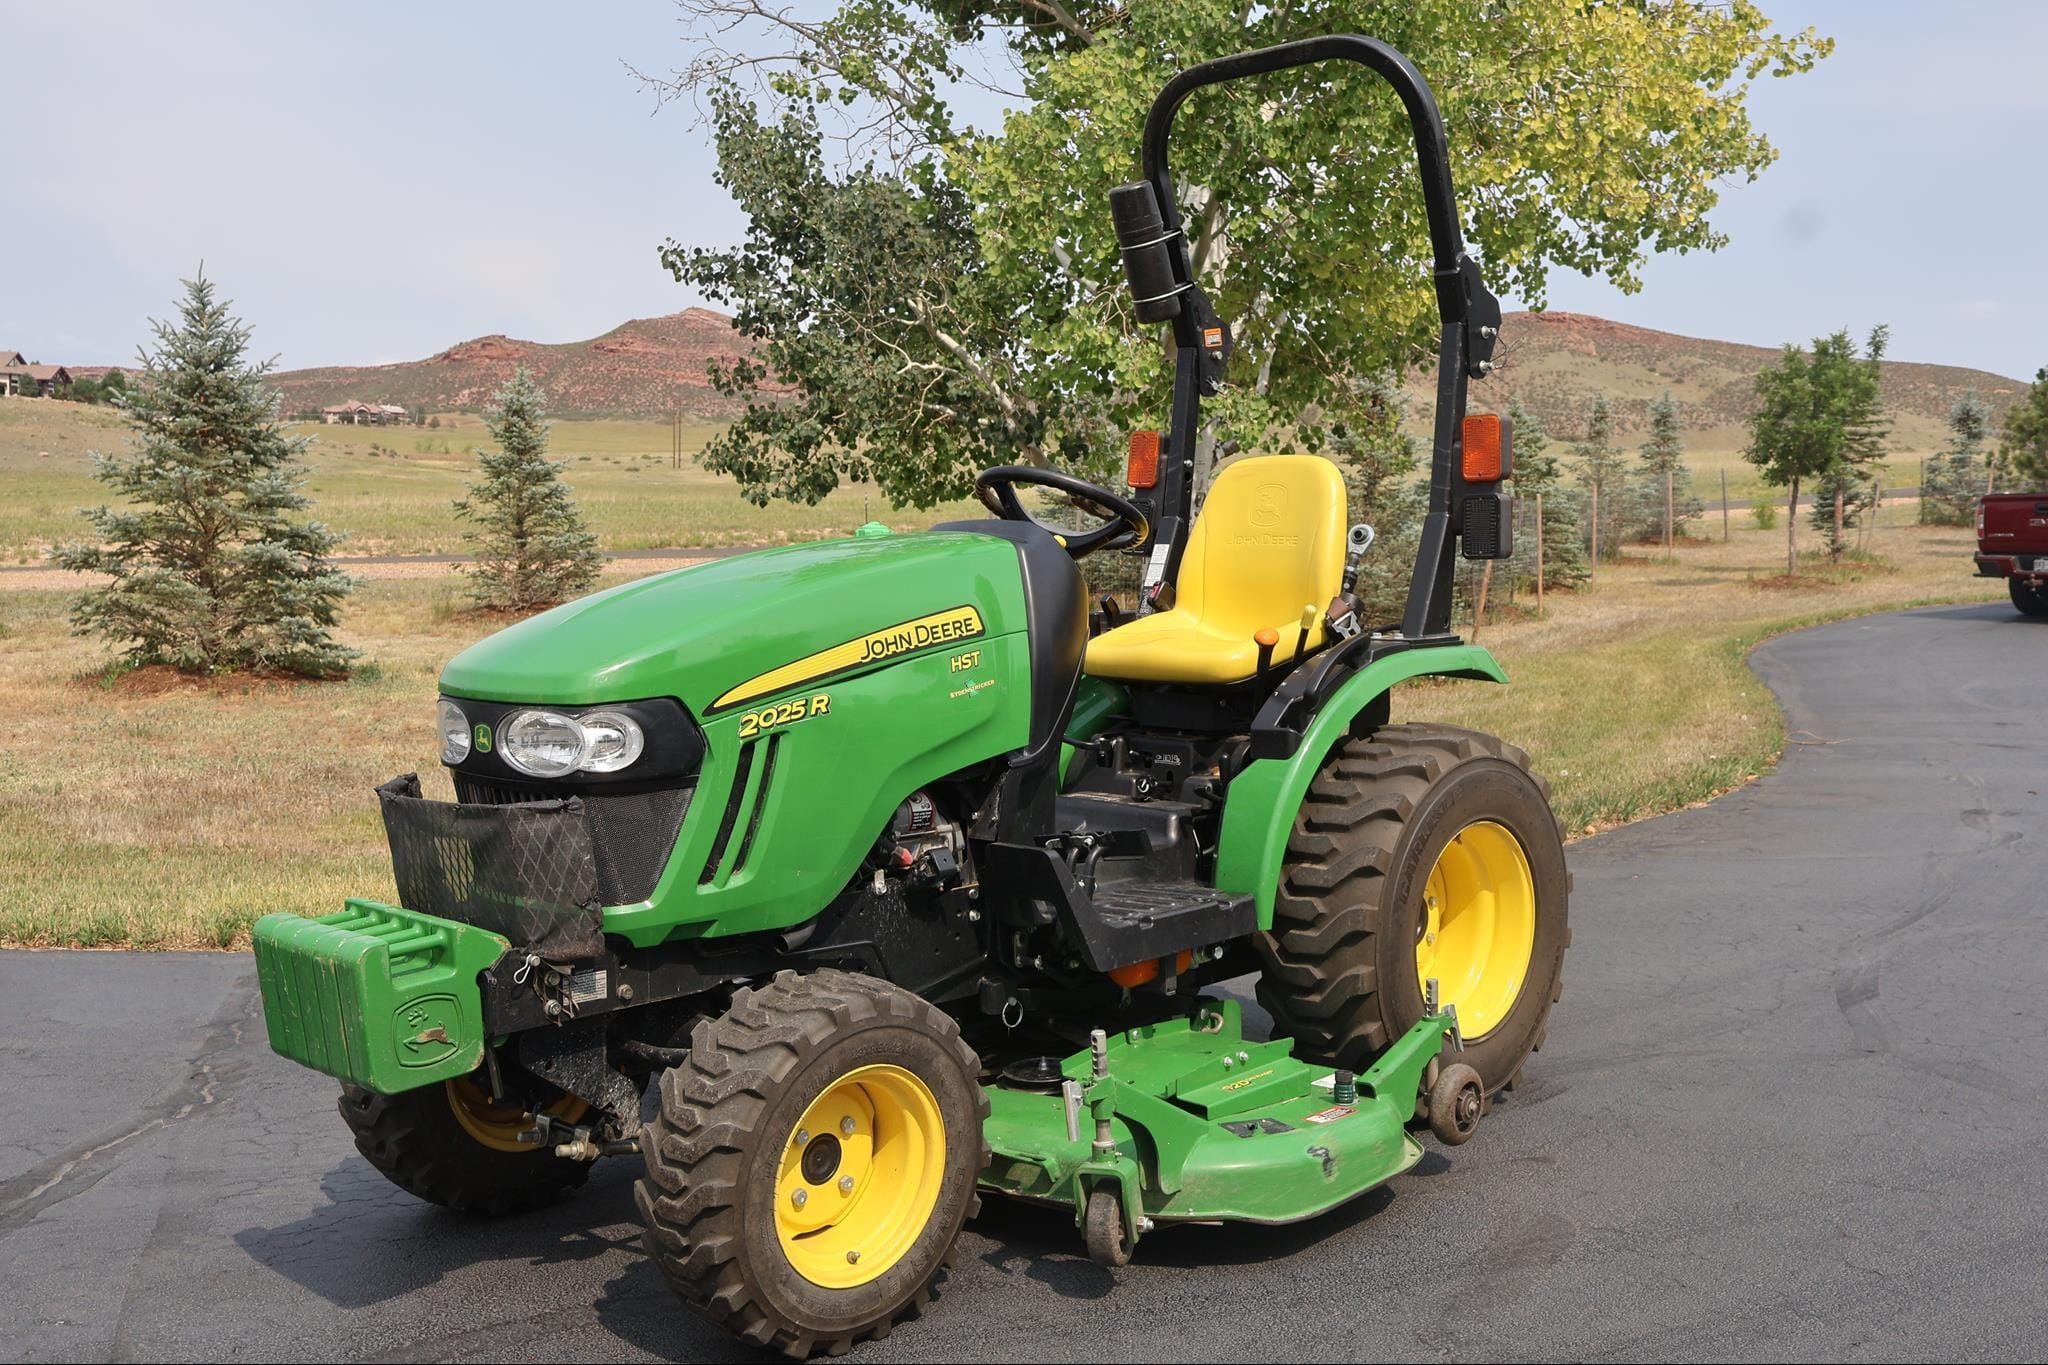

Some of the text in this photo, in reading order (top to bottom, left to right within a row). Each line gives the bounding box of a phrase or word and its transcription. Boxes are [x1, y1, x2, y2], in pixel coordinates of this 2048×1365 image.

[1226, 532, 1299, 545] JOHN DEERE
[860, 617, 975, 661] JOHN DEERE
[950, 649, 981, 673] HST
[739, 694, 831, 738] 2025 R
